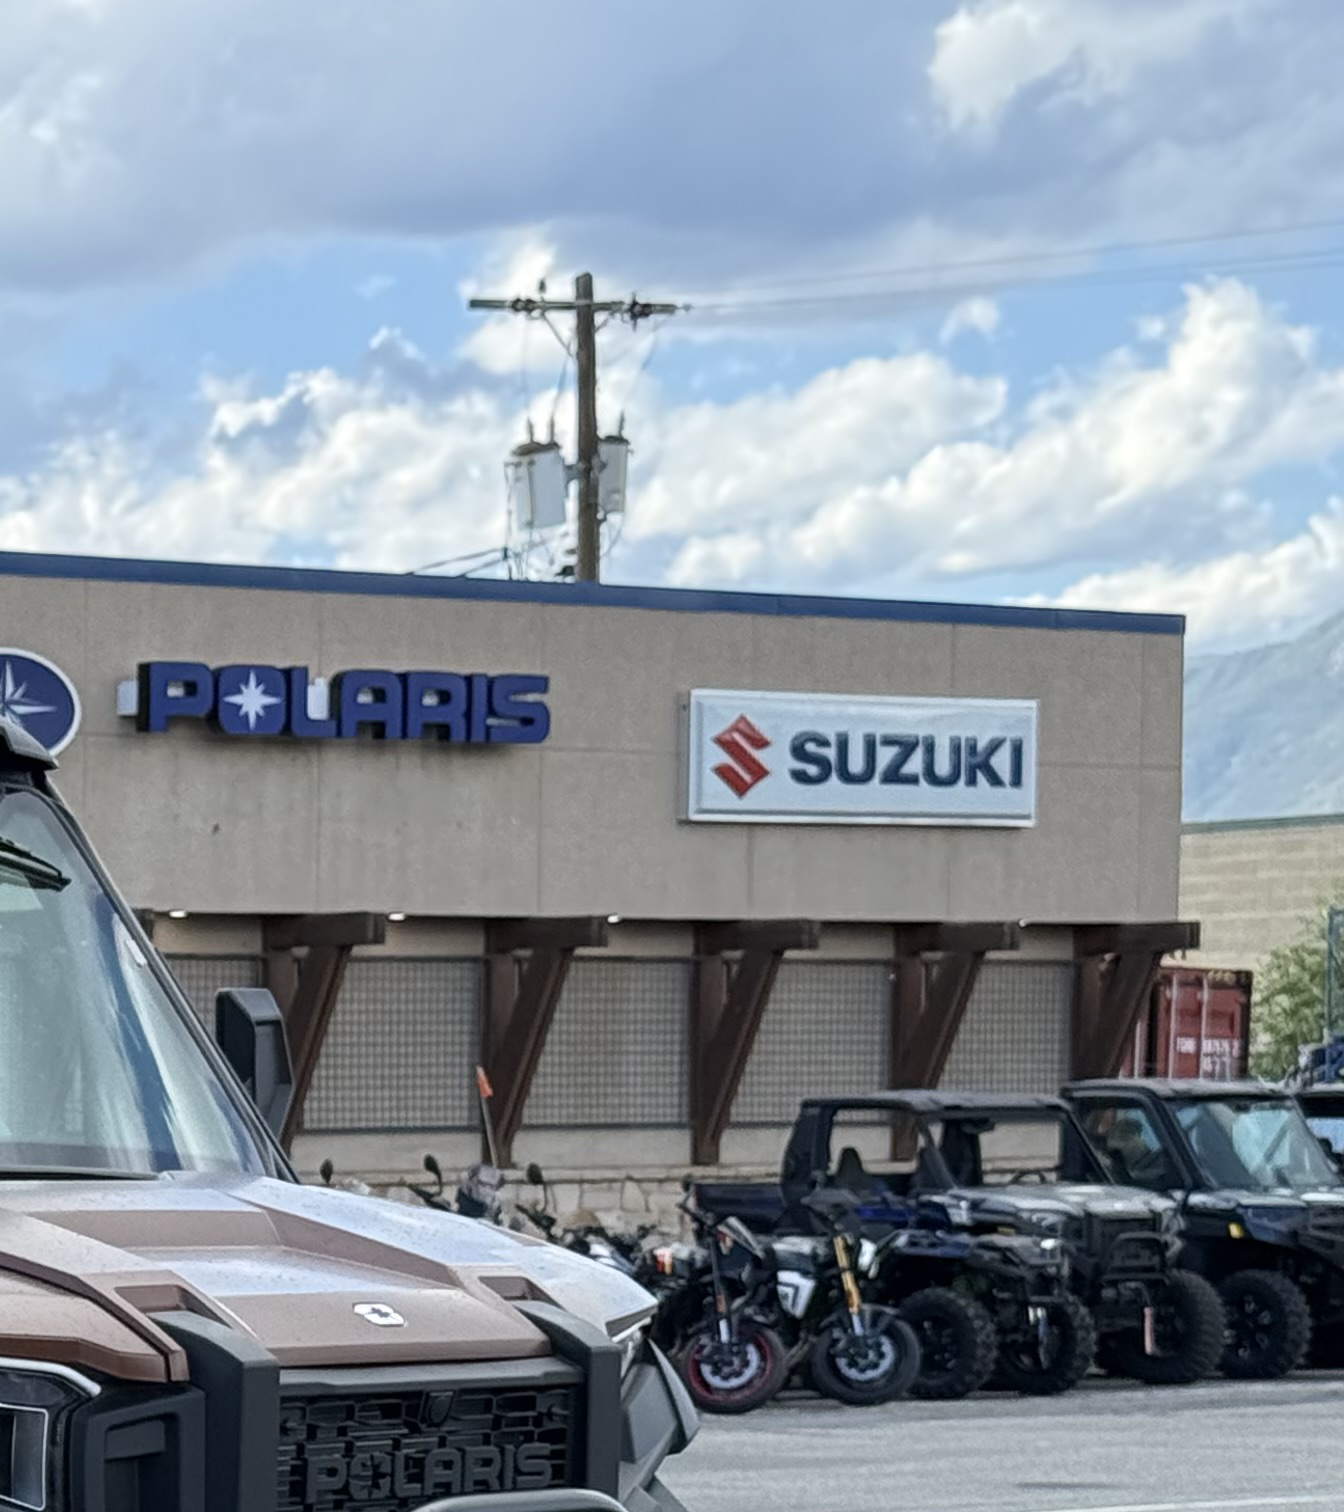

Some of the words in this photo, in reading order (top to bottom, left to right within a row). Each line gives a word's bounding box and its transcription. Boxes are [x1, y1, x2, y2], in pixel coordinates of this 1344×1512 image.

[137, 661, 550, 743] POLARIS
[789, 731, 1023, 788] SUZUKI
[306, 1442, 552, 1504] POLARIS
